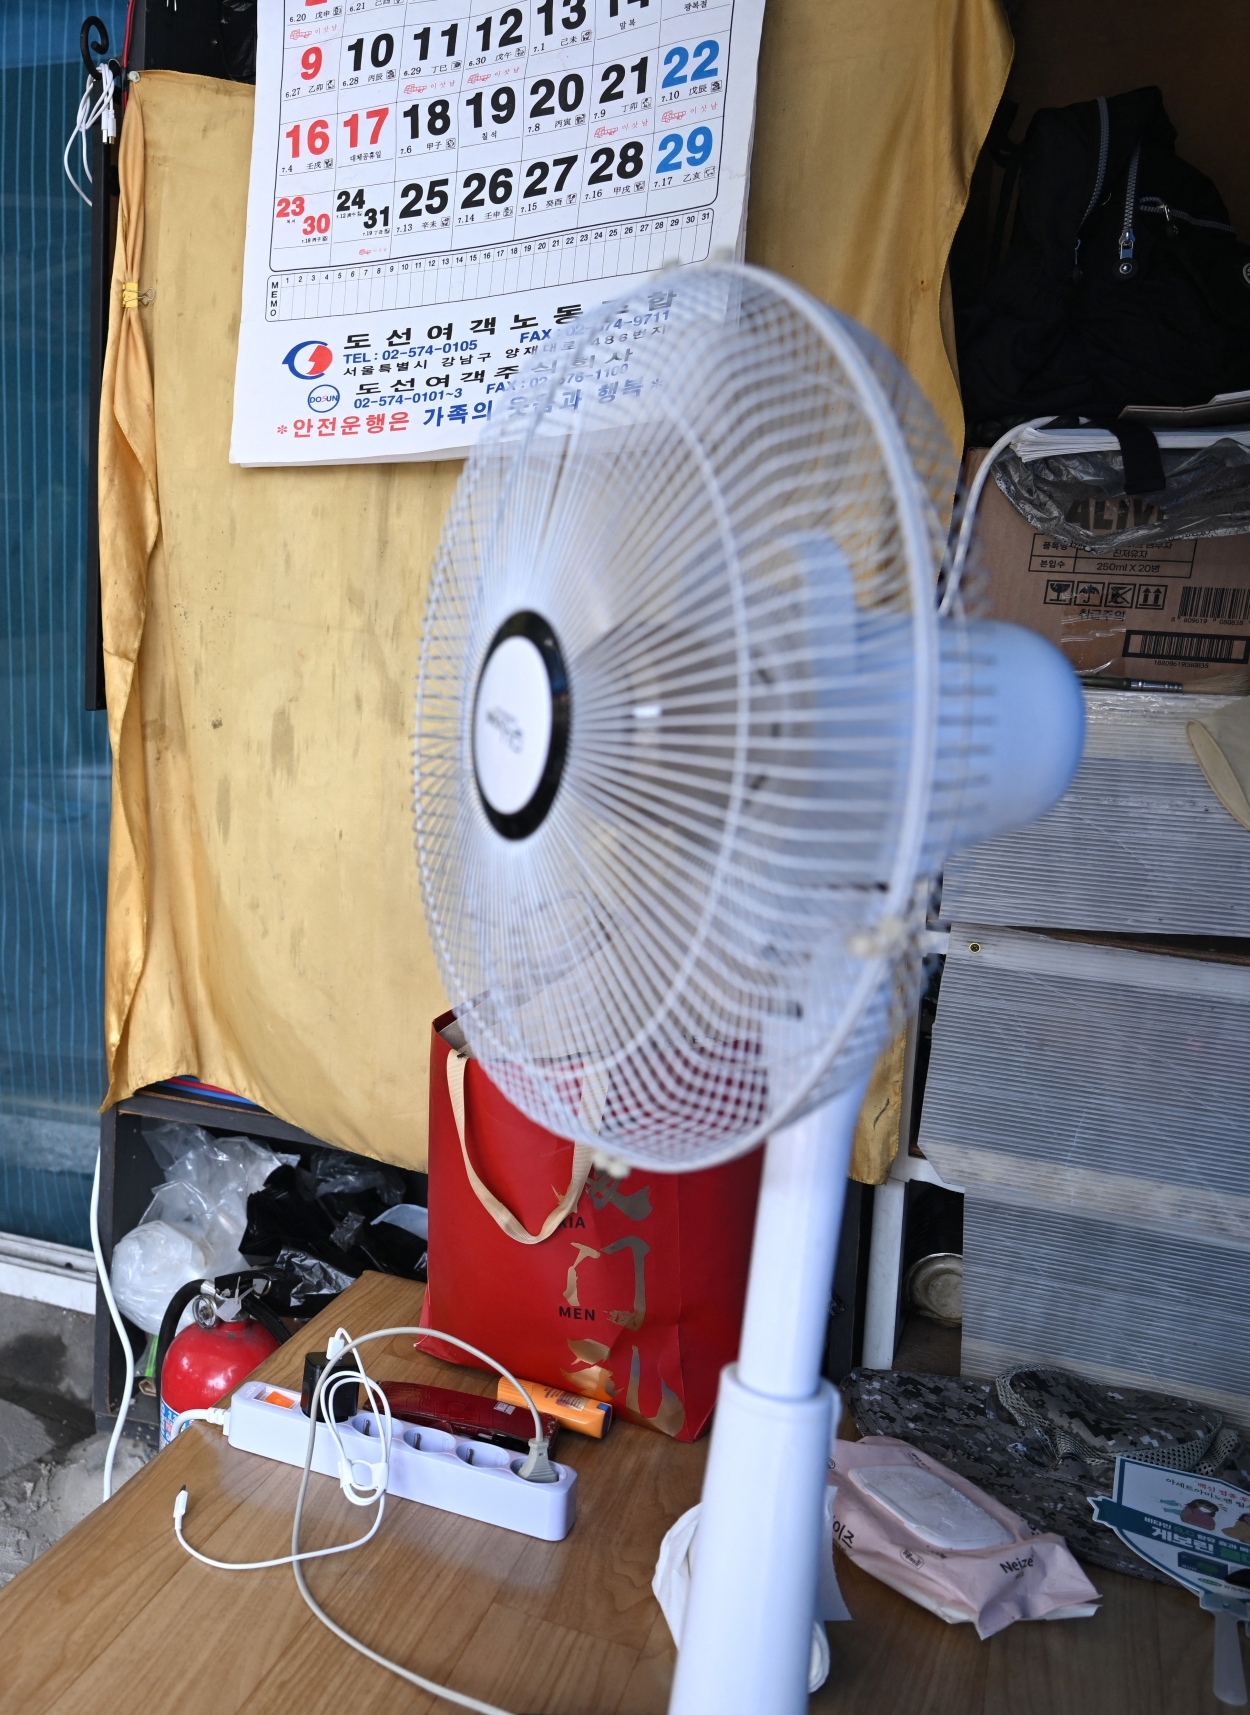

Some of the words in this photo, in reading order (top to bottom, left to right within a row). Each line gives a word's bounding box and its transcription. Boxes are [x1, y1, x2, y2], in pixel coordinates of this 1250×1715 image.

[476, 8, 523, 52] 12
[537, 0, 587, 36] 13
[348, 33, 395, 72] 10
[413, 23, 458, 61] 11
[301, 46, 323, 81] 9
[599, 56, 649, 104] 21
[661, 39, 720, 89] 22
[466, 86, 516, 129] 19
[529, 73, 584, 118] 20
[343, 107, 389, 148] 17
[403, 99, 451, 139] 18
[286, 119, 330, 159] 16
[400, 146, 412, 155] 7.6
[655, 126, 713, 174] 29
[523, 154, 578, 199] 27
[588, 141, 644, 186] 28
[276, 196, 306, 218] 23
[336, 188, 365, 212] 24
[399, 178, 449, 219] 25
[460, 168, 513, 209] 26
[302, 213, 330, 235] 30
[363, 206, 390, 229] 31
[401, 263, 409, 271] 10
[469, 254, 477, 262] 15
[497, 249, 504, 257] 17
[510, 247, 518, 255] 18
[538, 242, 547, 250] 20
[552, 239, 560, 248] 21
[565, 237, 574, 245] 22
[579, 234, 589, 242] 23
[594, 231, 603, 240] 24
[608, 228, 618, 237] 25
[624, 226, 633, 235] 26
[640, 224, 649, 232] 27
[655, 221, 664, 230] 28
[670, 218, 679, 227] 29
[686, 215, 695, 224] 30
[701, 212, 710, 221] 31
[270, 281, 279, 317] MEMO
[382, 339, 478, 361] 02-574-0105
[565, 310, 670, 337] 02-74-9711
[343, 360, 428, 377] 서울특별시
[441, 352, 492, 367] 강남구
[309, 394, 338, 404] DOSUN
[354, 388, 463, 409] 02-574-0101~3
[293, 411, 410, 439] 안전운행은
[423, 400, 493, 427] 가족의
[1065, 499, 1166, 531] ALIV
[1096, 562, 1128, 572] 250ml
[558, 1306, 596, 1321] MEN
[832, 1516, 854, 1549] 이즈
[1152, 1526, 1215, 1555] 게보린
[1000, 1553, 1034, 1574] Neize
